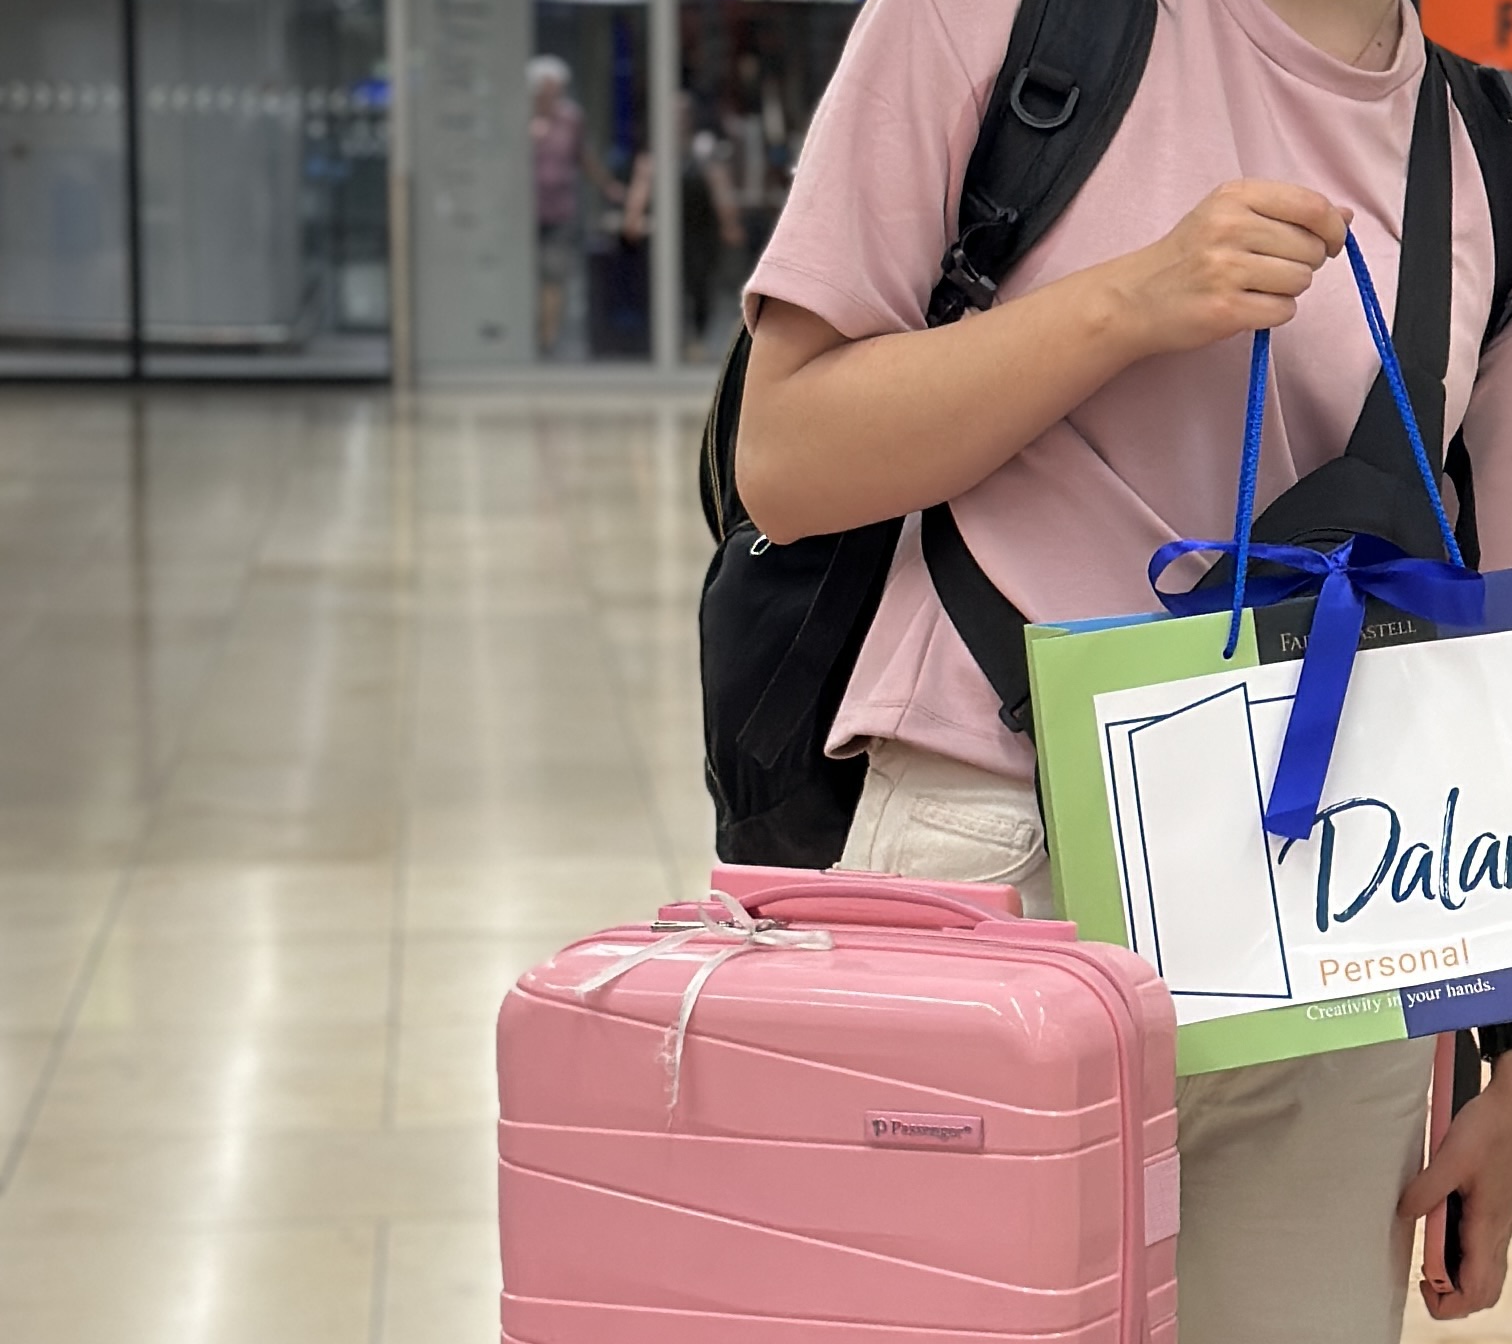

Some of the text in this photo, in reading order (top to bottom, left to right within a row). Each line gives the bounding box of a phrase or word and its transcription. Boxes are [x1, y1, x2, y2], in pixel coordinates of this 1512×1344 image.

[1279, 619, 1418, 652] FASTELL
[1319, 938, 1470, 986] Personal
[1306, 978, 1496, 1020] Creativity in your hands.
